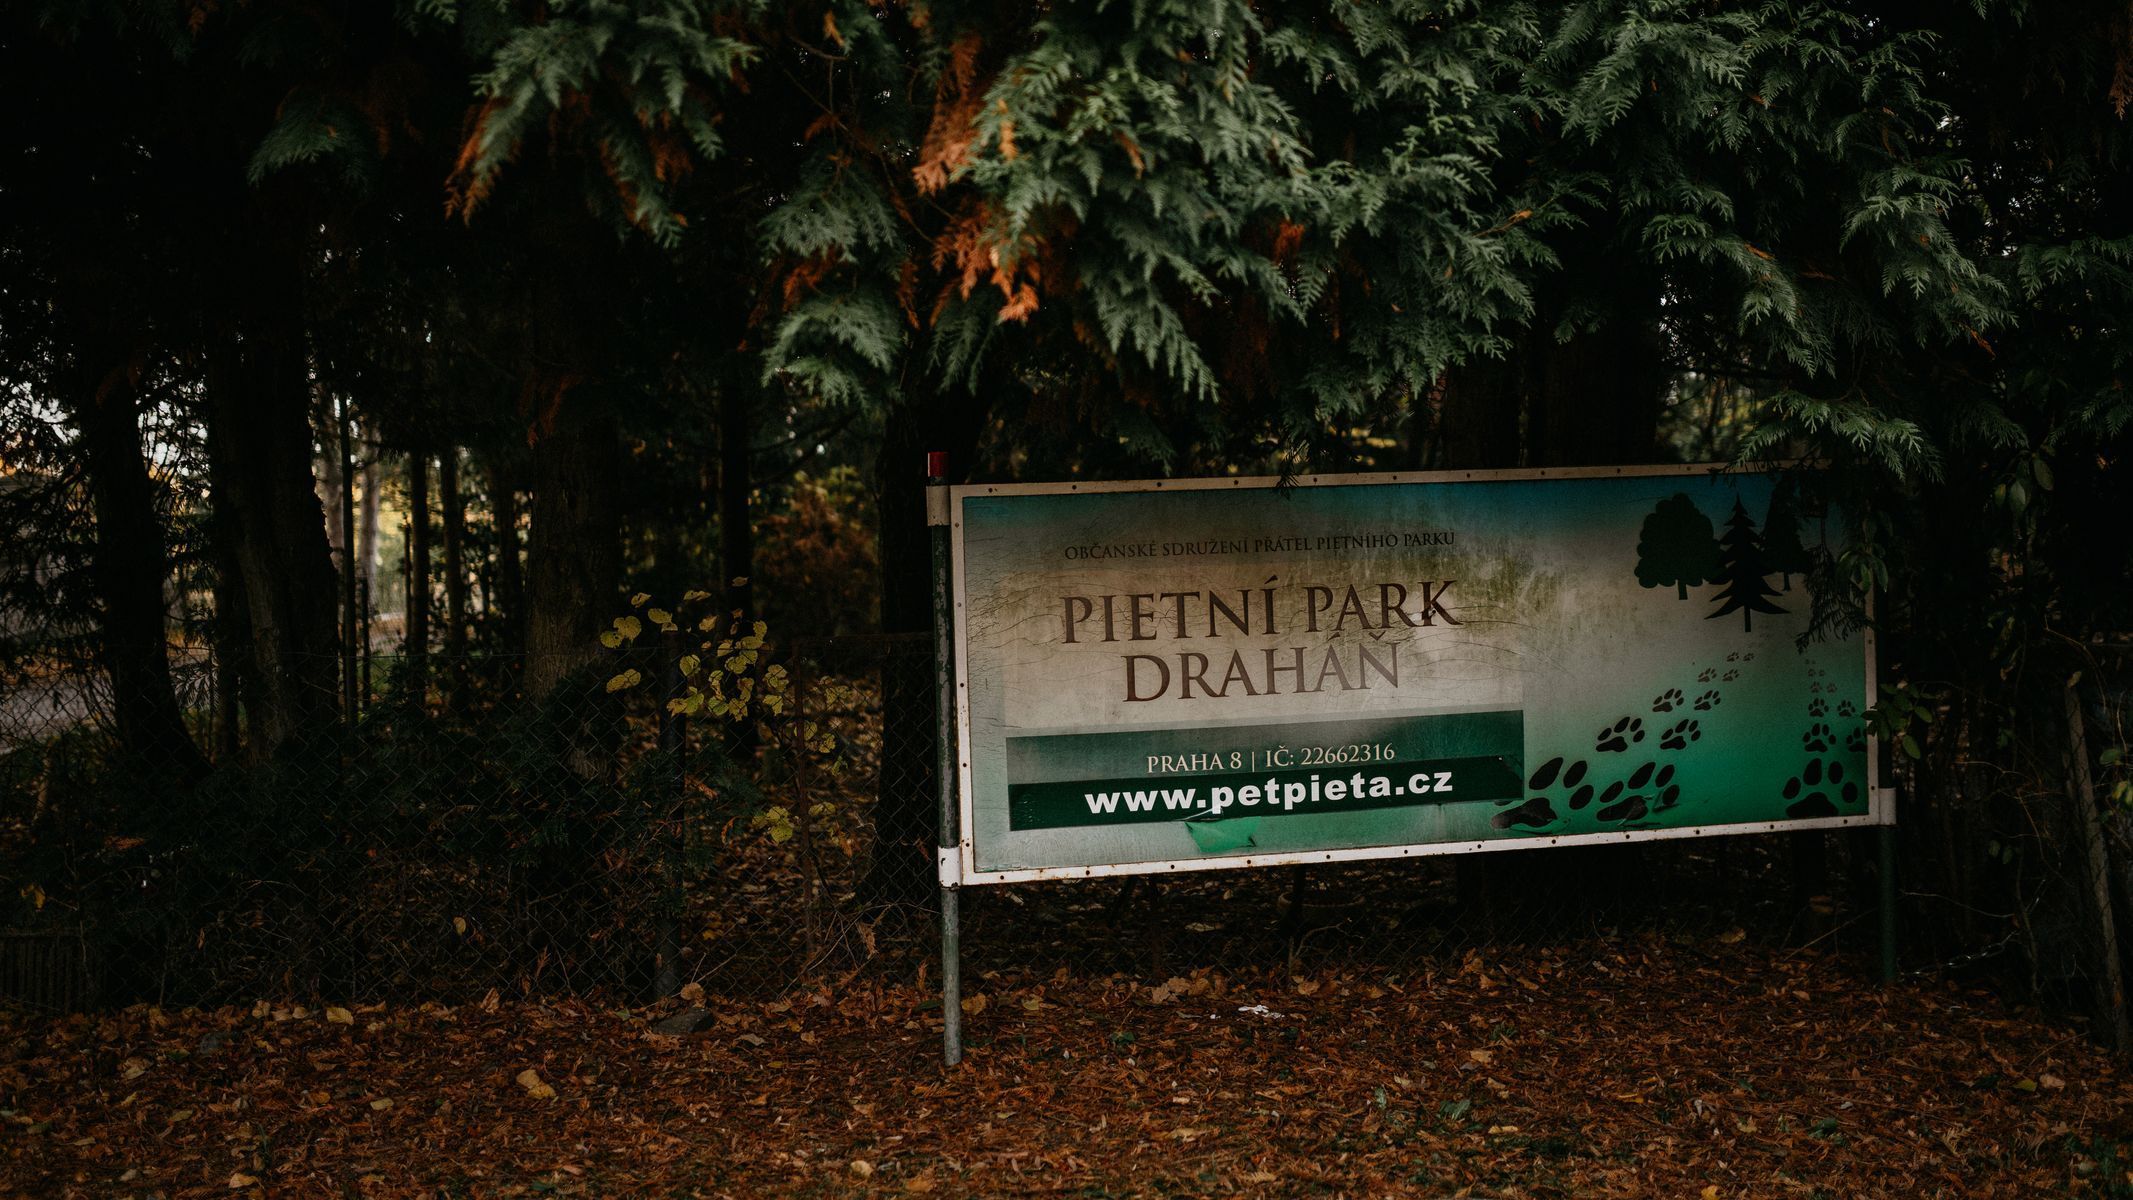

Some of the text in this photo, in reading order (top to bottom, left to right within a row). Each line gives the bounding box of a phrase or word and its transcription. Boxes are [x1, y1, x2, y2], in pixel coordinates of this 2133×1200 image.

[1064, 531, 1456, 560] OBČANSKÉ SDRUŽENÍ PŘÁTEL PIETNÍHO PARKU
[1060, 575, 1464, 644] PIETNÍ PARK
[1121, 631, 1401, 703] DRAHÁŇ
[1146, 753, 1225, 774] PRAHA
[1230, 751, 1243, 770] 8
[1265, 745, 1295, 768] IČ:
[1300, 743, 1396, 766] 22662316
[1084, 771, 1454, 815] www.petpieta.cz
